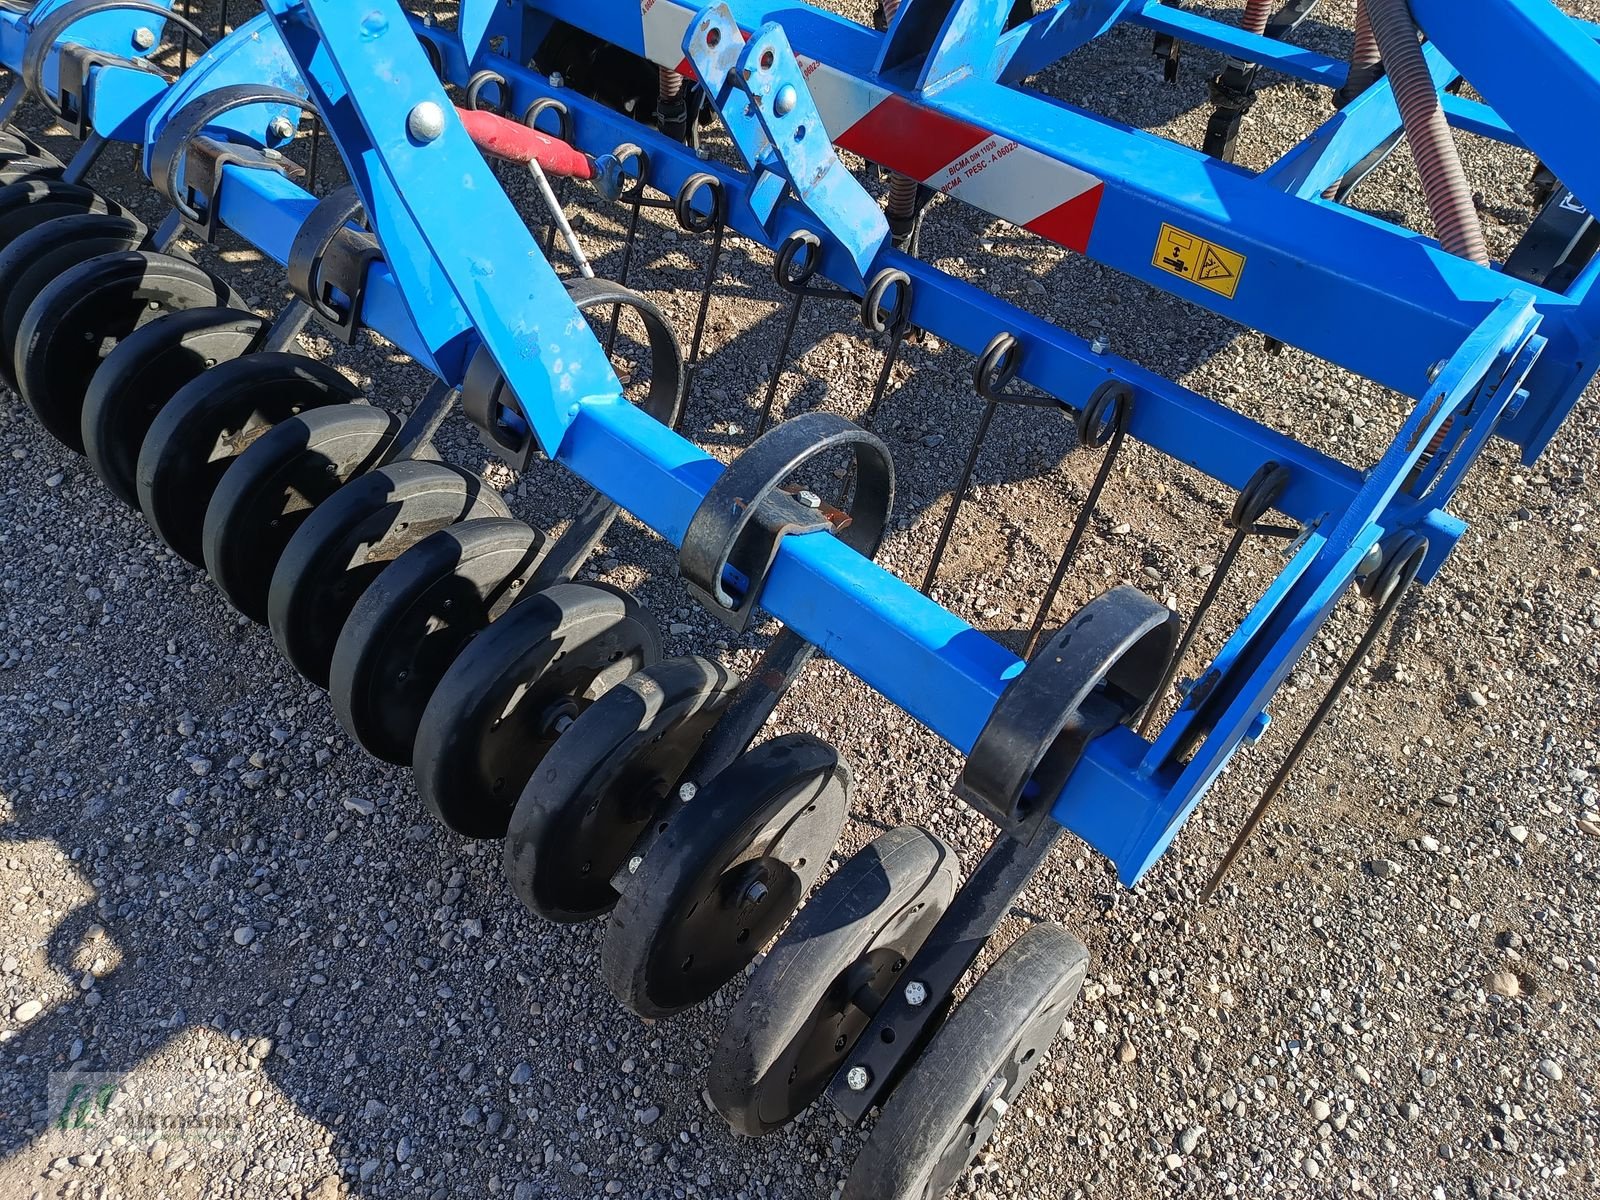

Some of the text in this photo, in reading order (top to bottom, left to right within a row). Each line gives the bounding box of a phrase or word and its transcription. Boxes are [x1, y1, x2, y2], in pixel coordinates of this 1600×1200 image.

[941, 176, 962, 193] BICMA
[964, 160, 987, 178] TPESC
[991, 153, 998, 163] A
[997, 141, 1018, 158] 06025
[948, 141, 997, 176] BICMA DIN 11030
